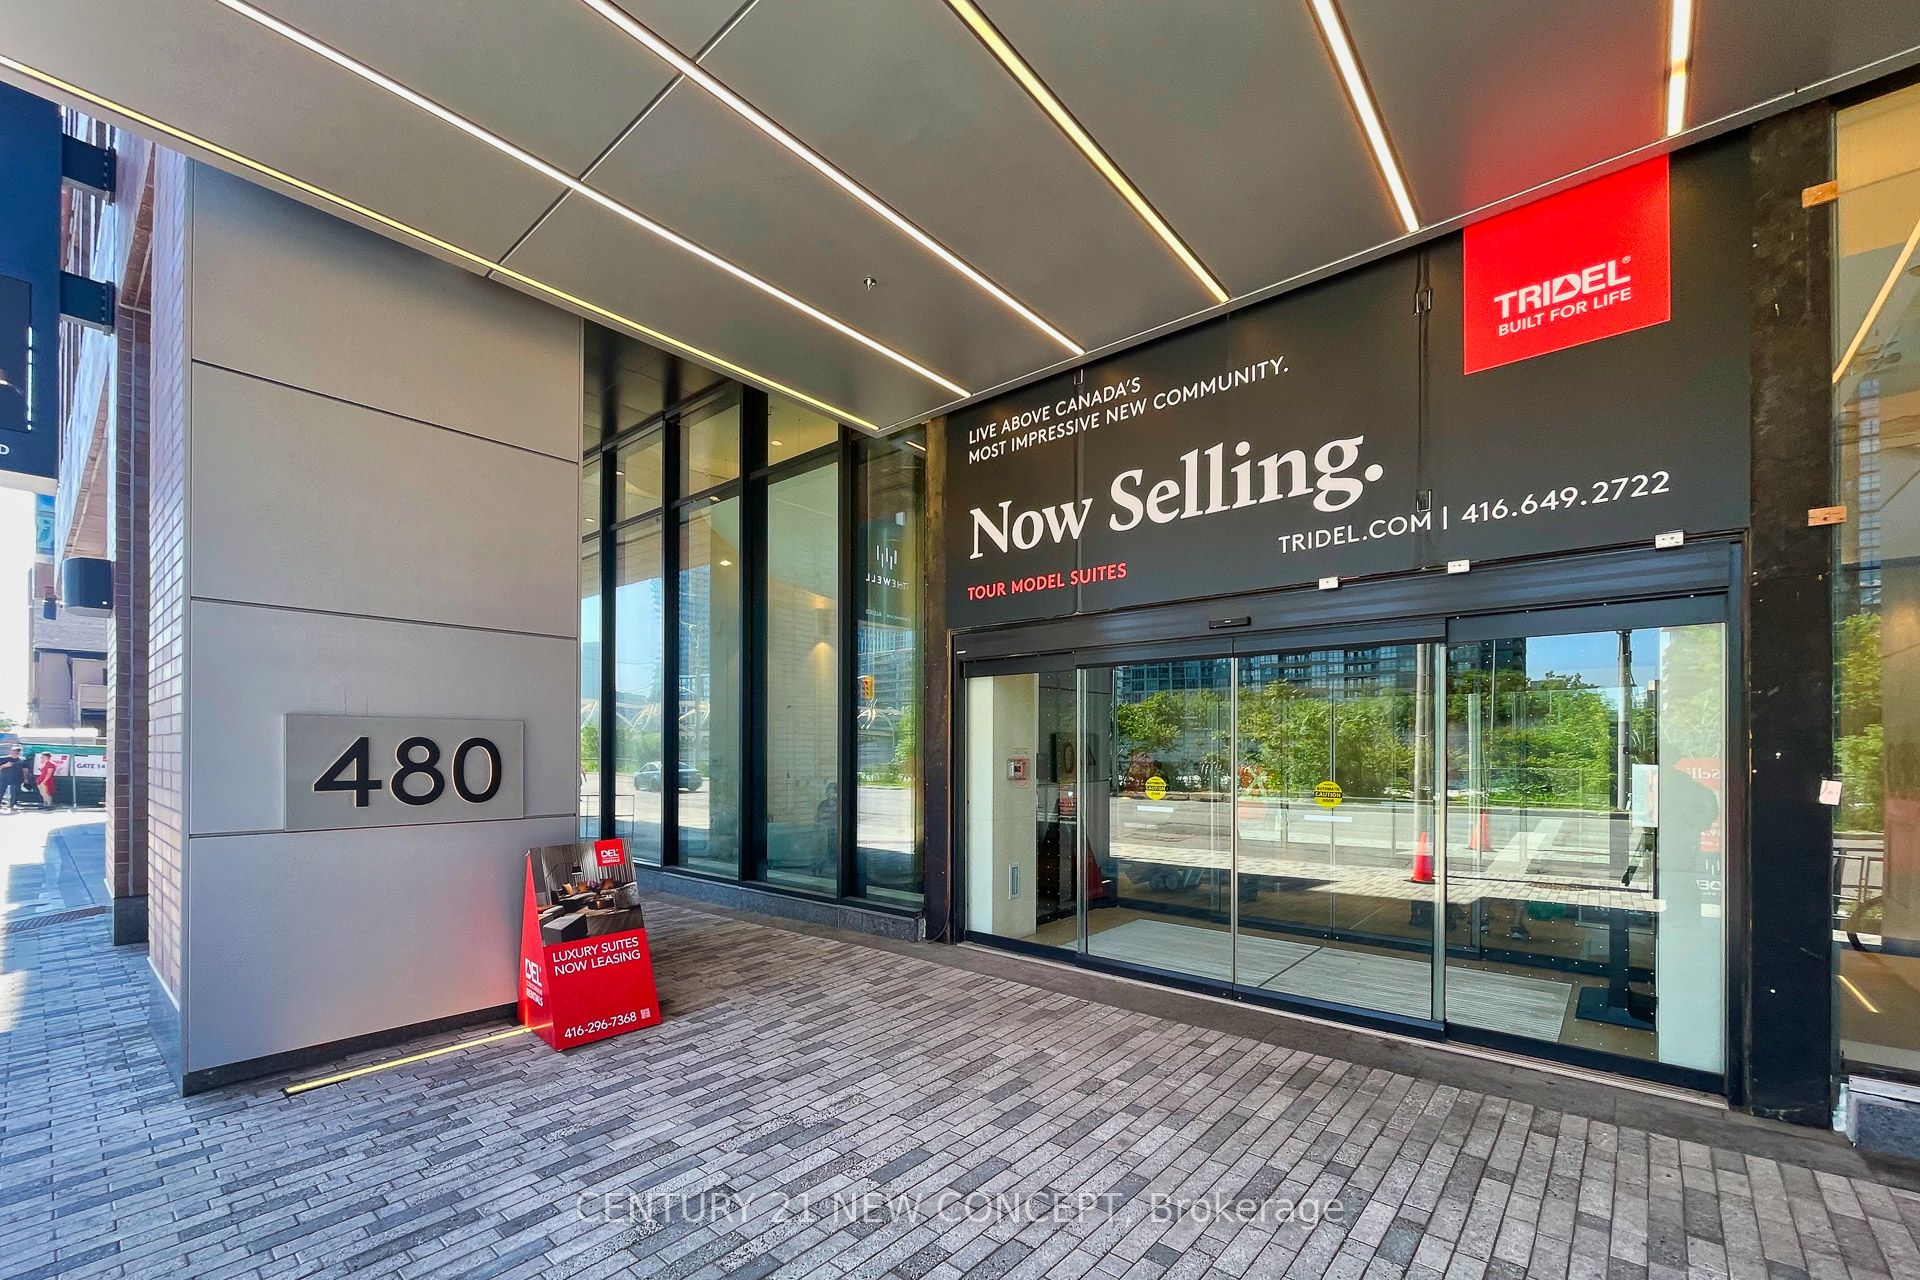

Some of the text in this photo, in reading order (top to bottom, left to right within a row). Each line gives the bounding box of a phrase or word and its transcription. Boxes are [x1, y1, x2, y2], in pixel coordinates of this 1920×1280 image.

[1498, 287, 1632, 336] BUILT FOR LIFE
[969, 376, 1141, 444] LIVE ABOVE CANADA'S
[969, 356, 1289, 464] MOST IMPRESSIVE NEW COMMUNITY.
[969, 434, 1384, 560] Now Selling.
[1278, 510, 1432, 554] TRIDEL.COM
[1461, 470, 1671, 524] 416.649.2722
[968, 561, 1128, 601] TOUR MODEL SUITES
[312, 735, 502, 808] 480
[601, 848, 619, 858] DEL
[552, 937, 639, 963] LUXURY SUITES
[554, 949, 641, 976] NOW LEASING
[564, 1011, 637, 1039] 416-296-7368
